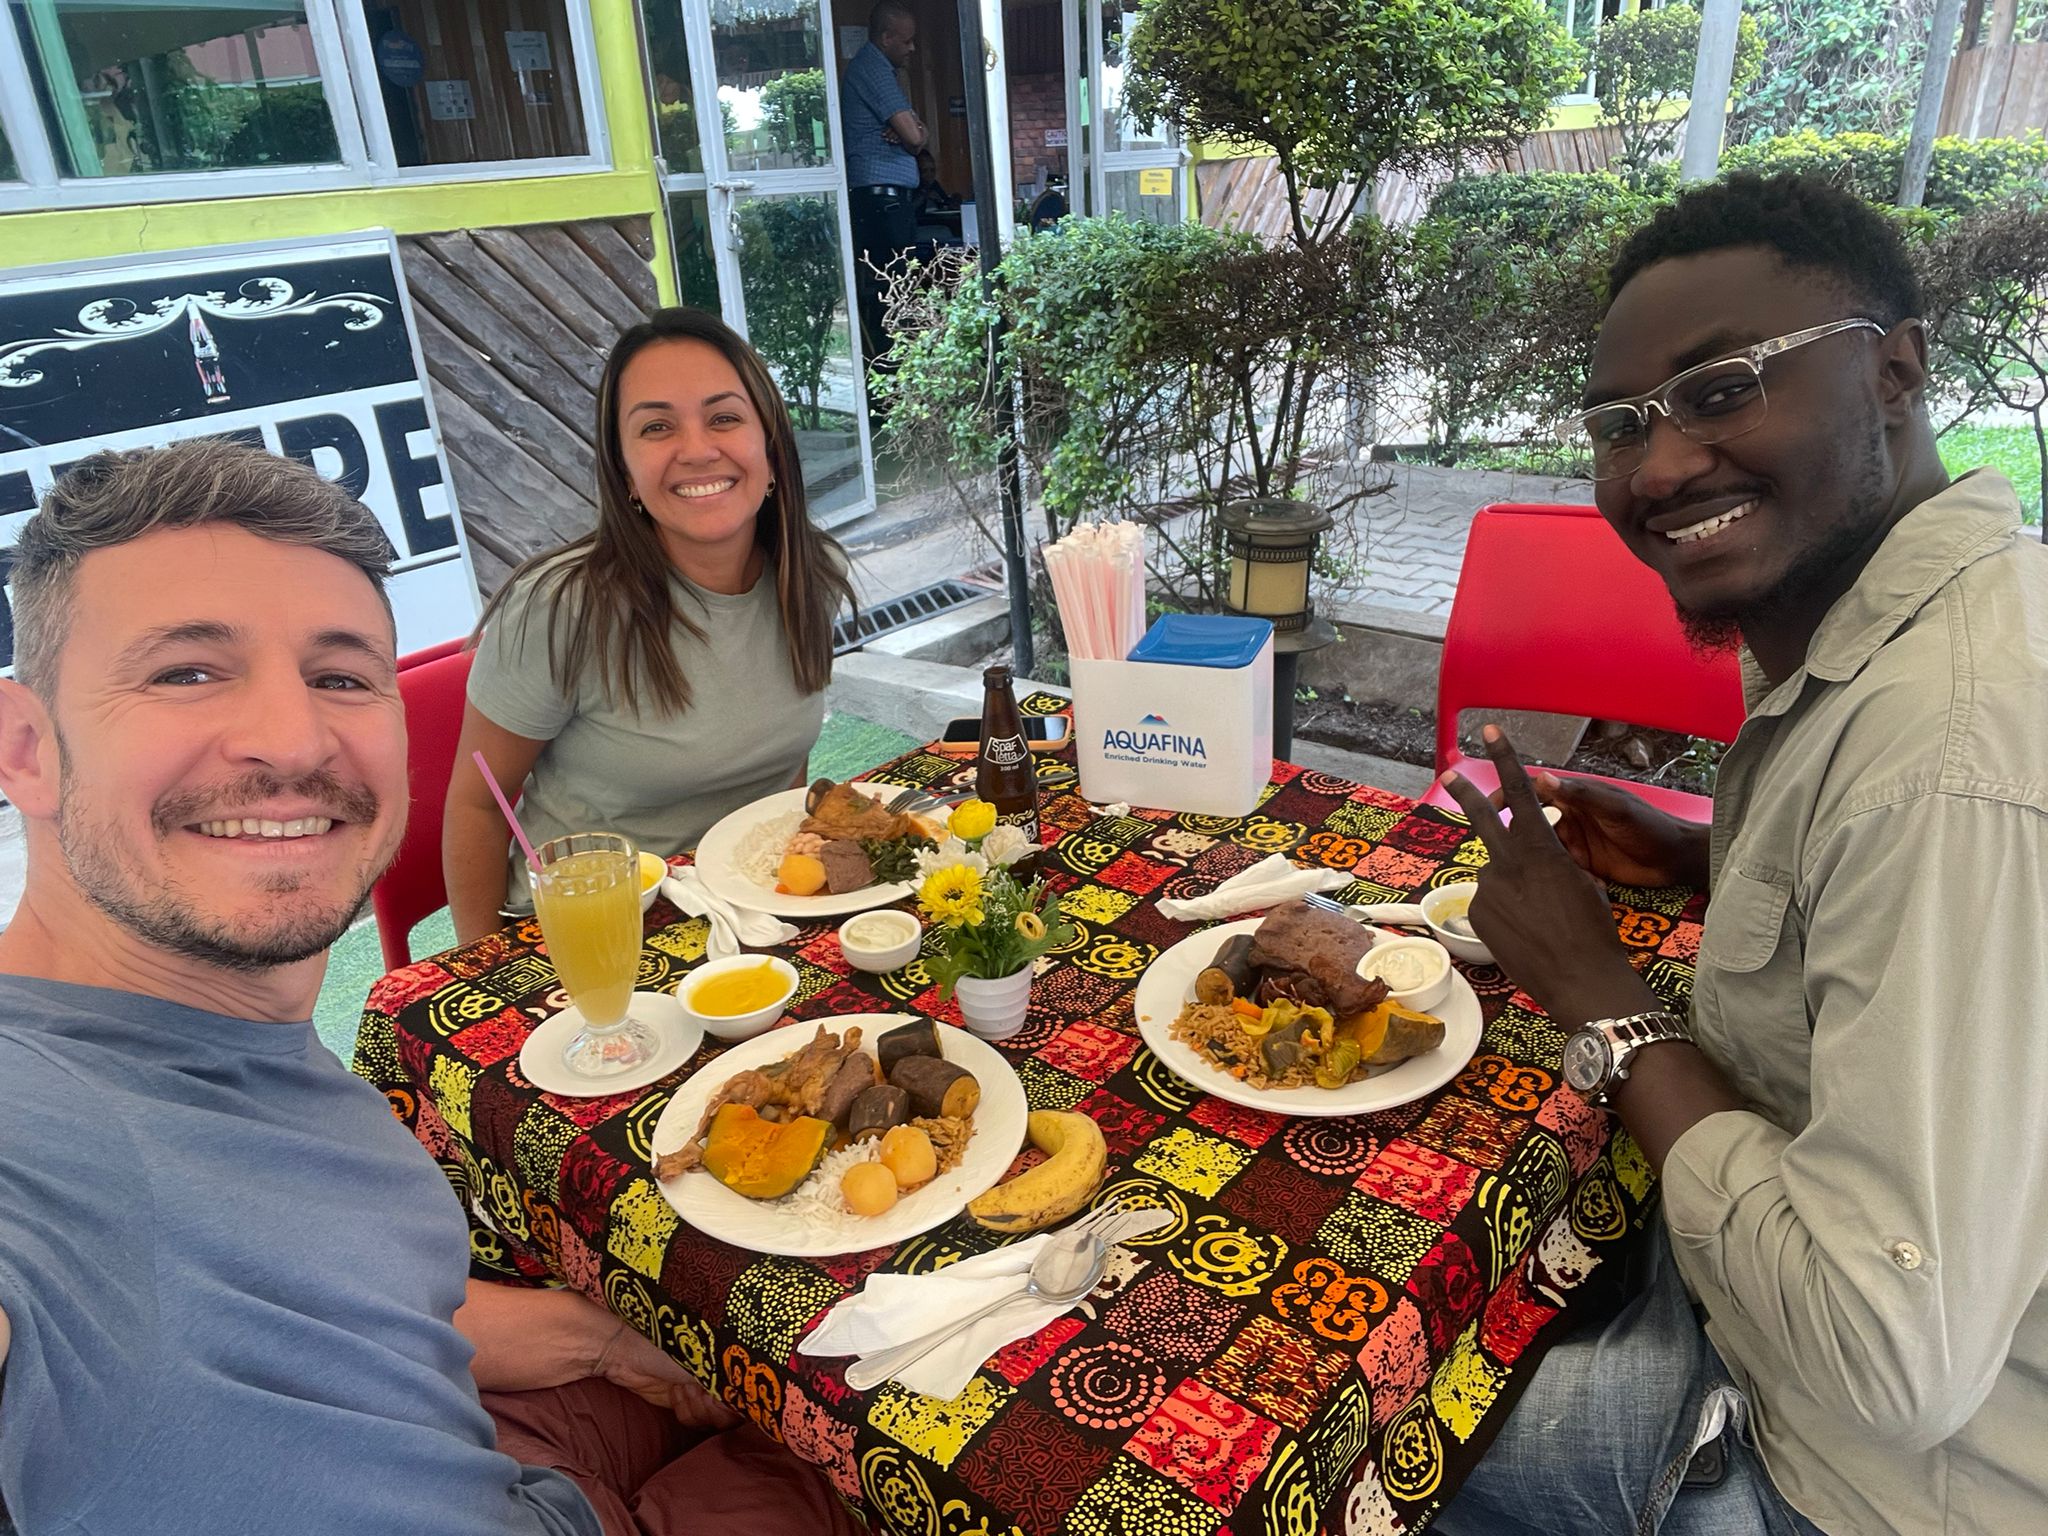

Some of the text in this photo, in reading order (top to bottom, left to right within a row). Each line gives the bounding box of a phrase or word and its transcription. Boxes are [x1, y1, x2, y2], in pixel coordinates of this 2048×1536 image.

[1103, 729, 1207, 760] AQUAFINA
[1104, 752, 1207, 769] Enriched Drinking Water
